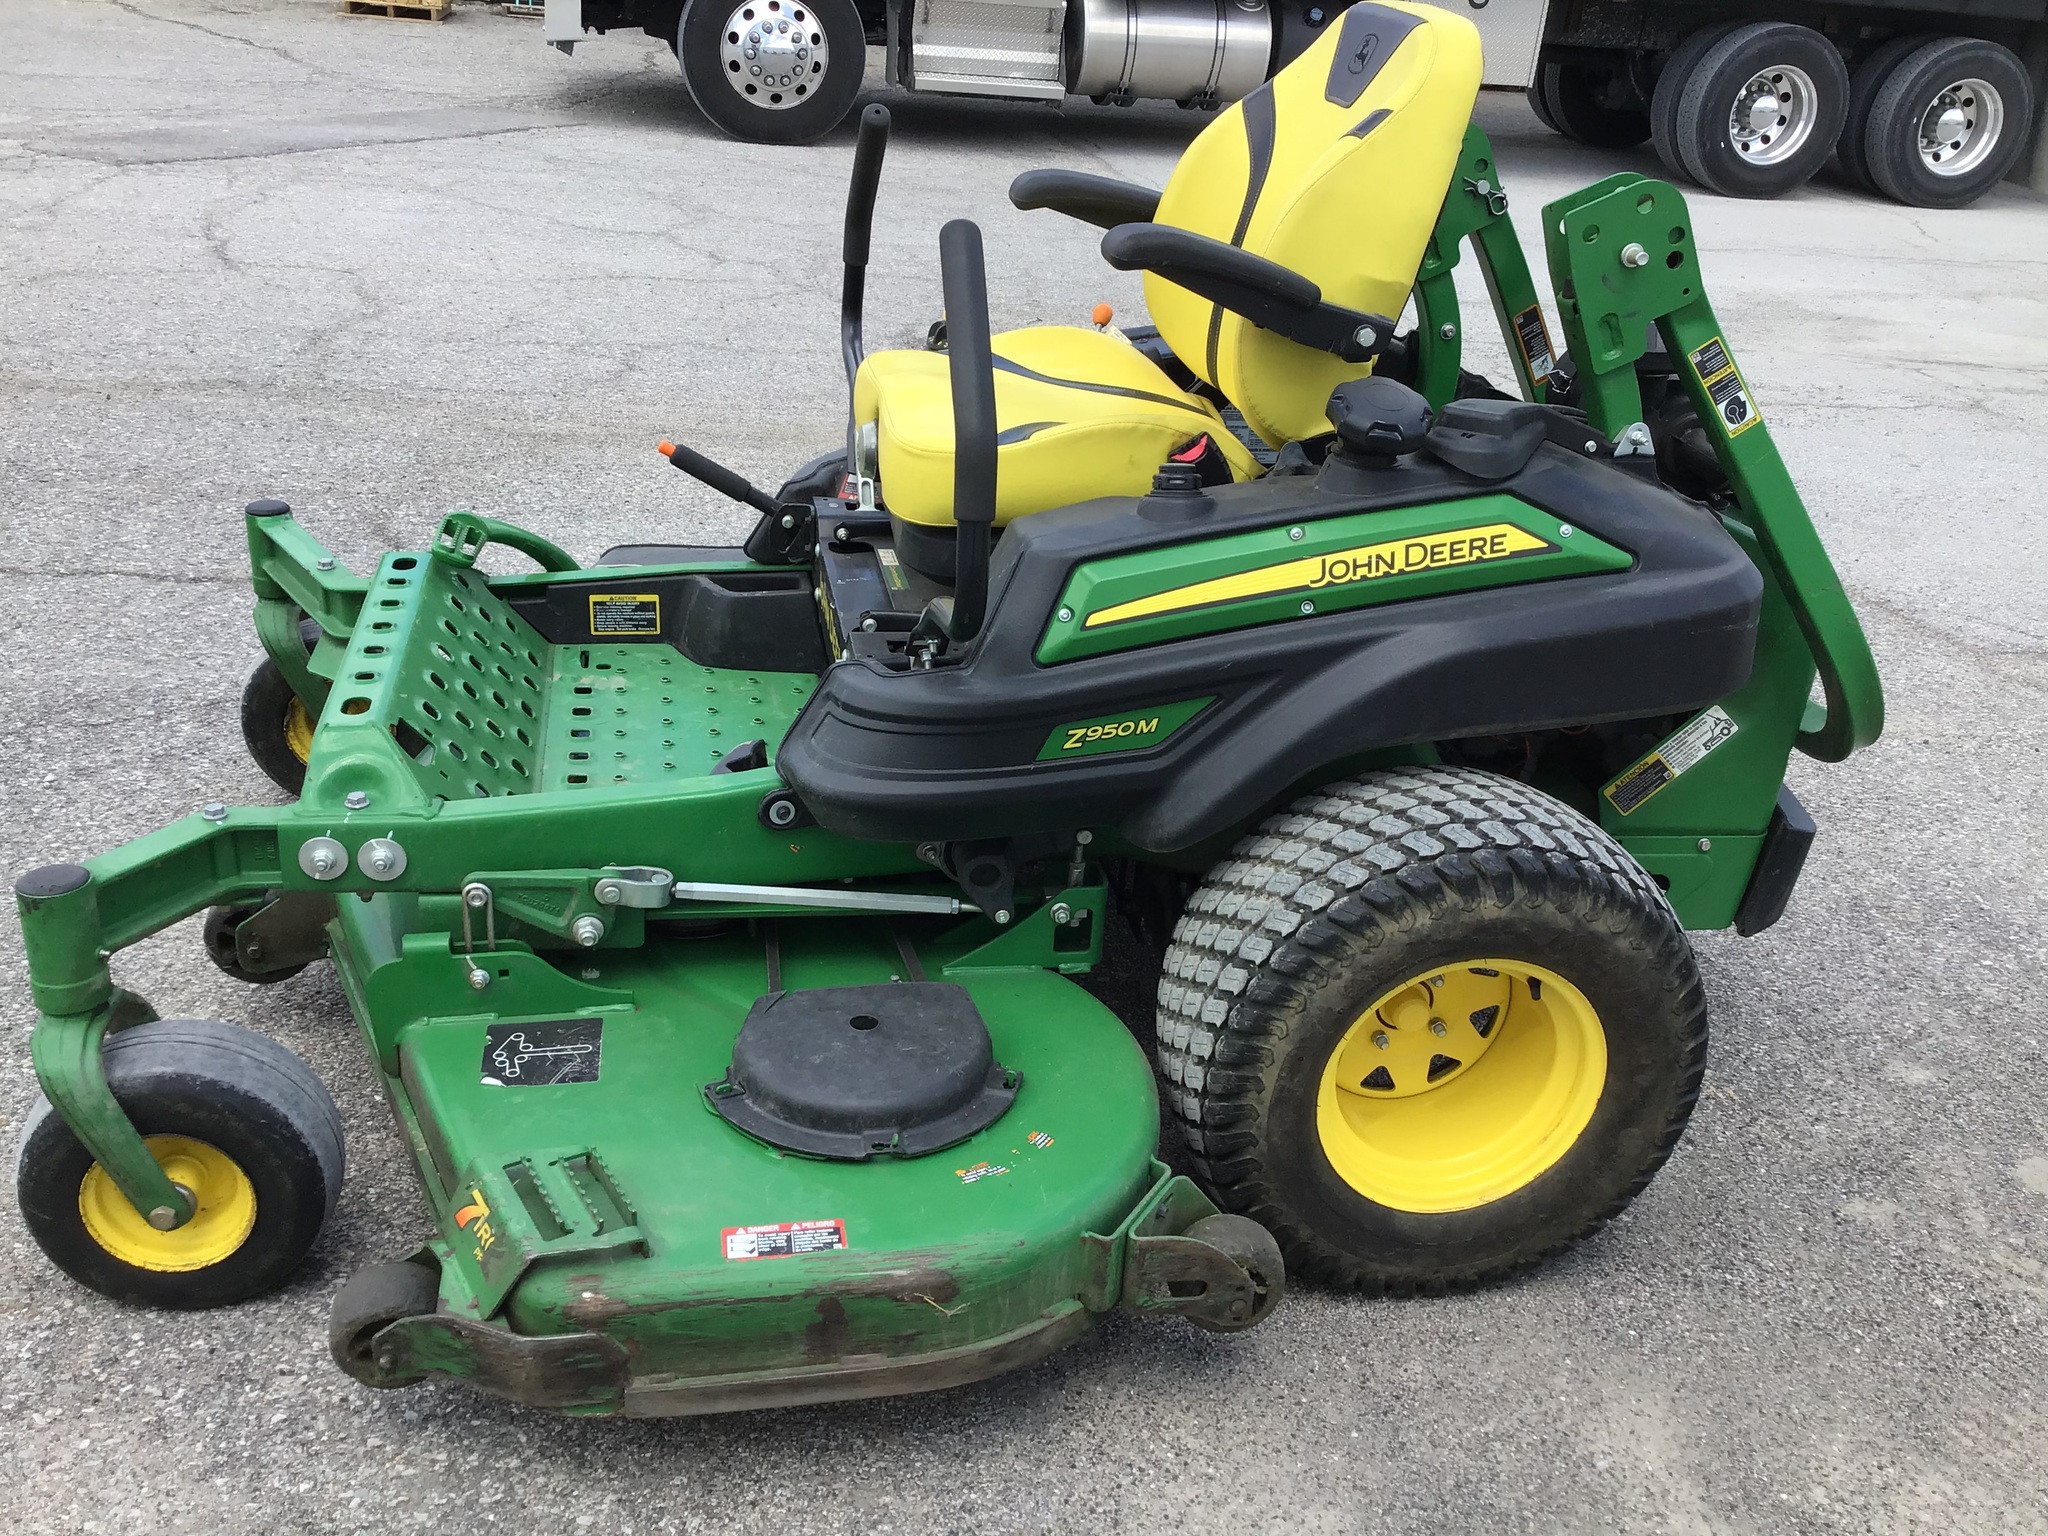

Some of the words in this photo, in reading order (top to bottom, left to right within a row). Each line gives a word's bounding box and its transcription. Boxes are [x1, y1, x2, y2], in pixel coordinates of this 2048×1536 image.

[1731, 420, 1755, 436] CAUTION
[1309, 551, 1396, 584] JOHN
[1404, 533, 1508, 569] DEERE
[1063, 717, 1159, 750] Z950M
[1619, 760, 1650, 785] ATENCIÓN
[747, 1225, 779, 1234] DANGER
[801, 1219, 835, 1229] PELIGRO
